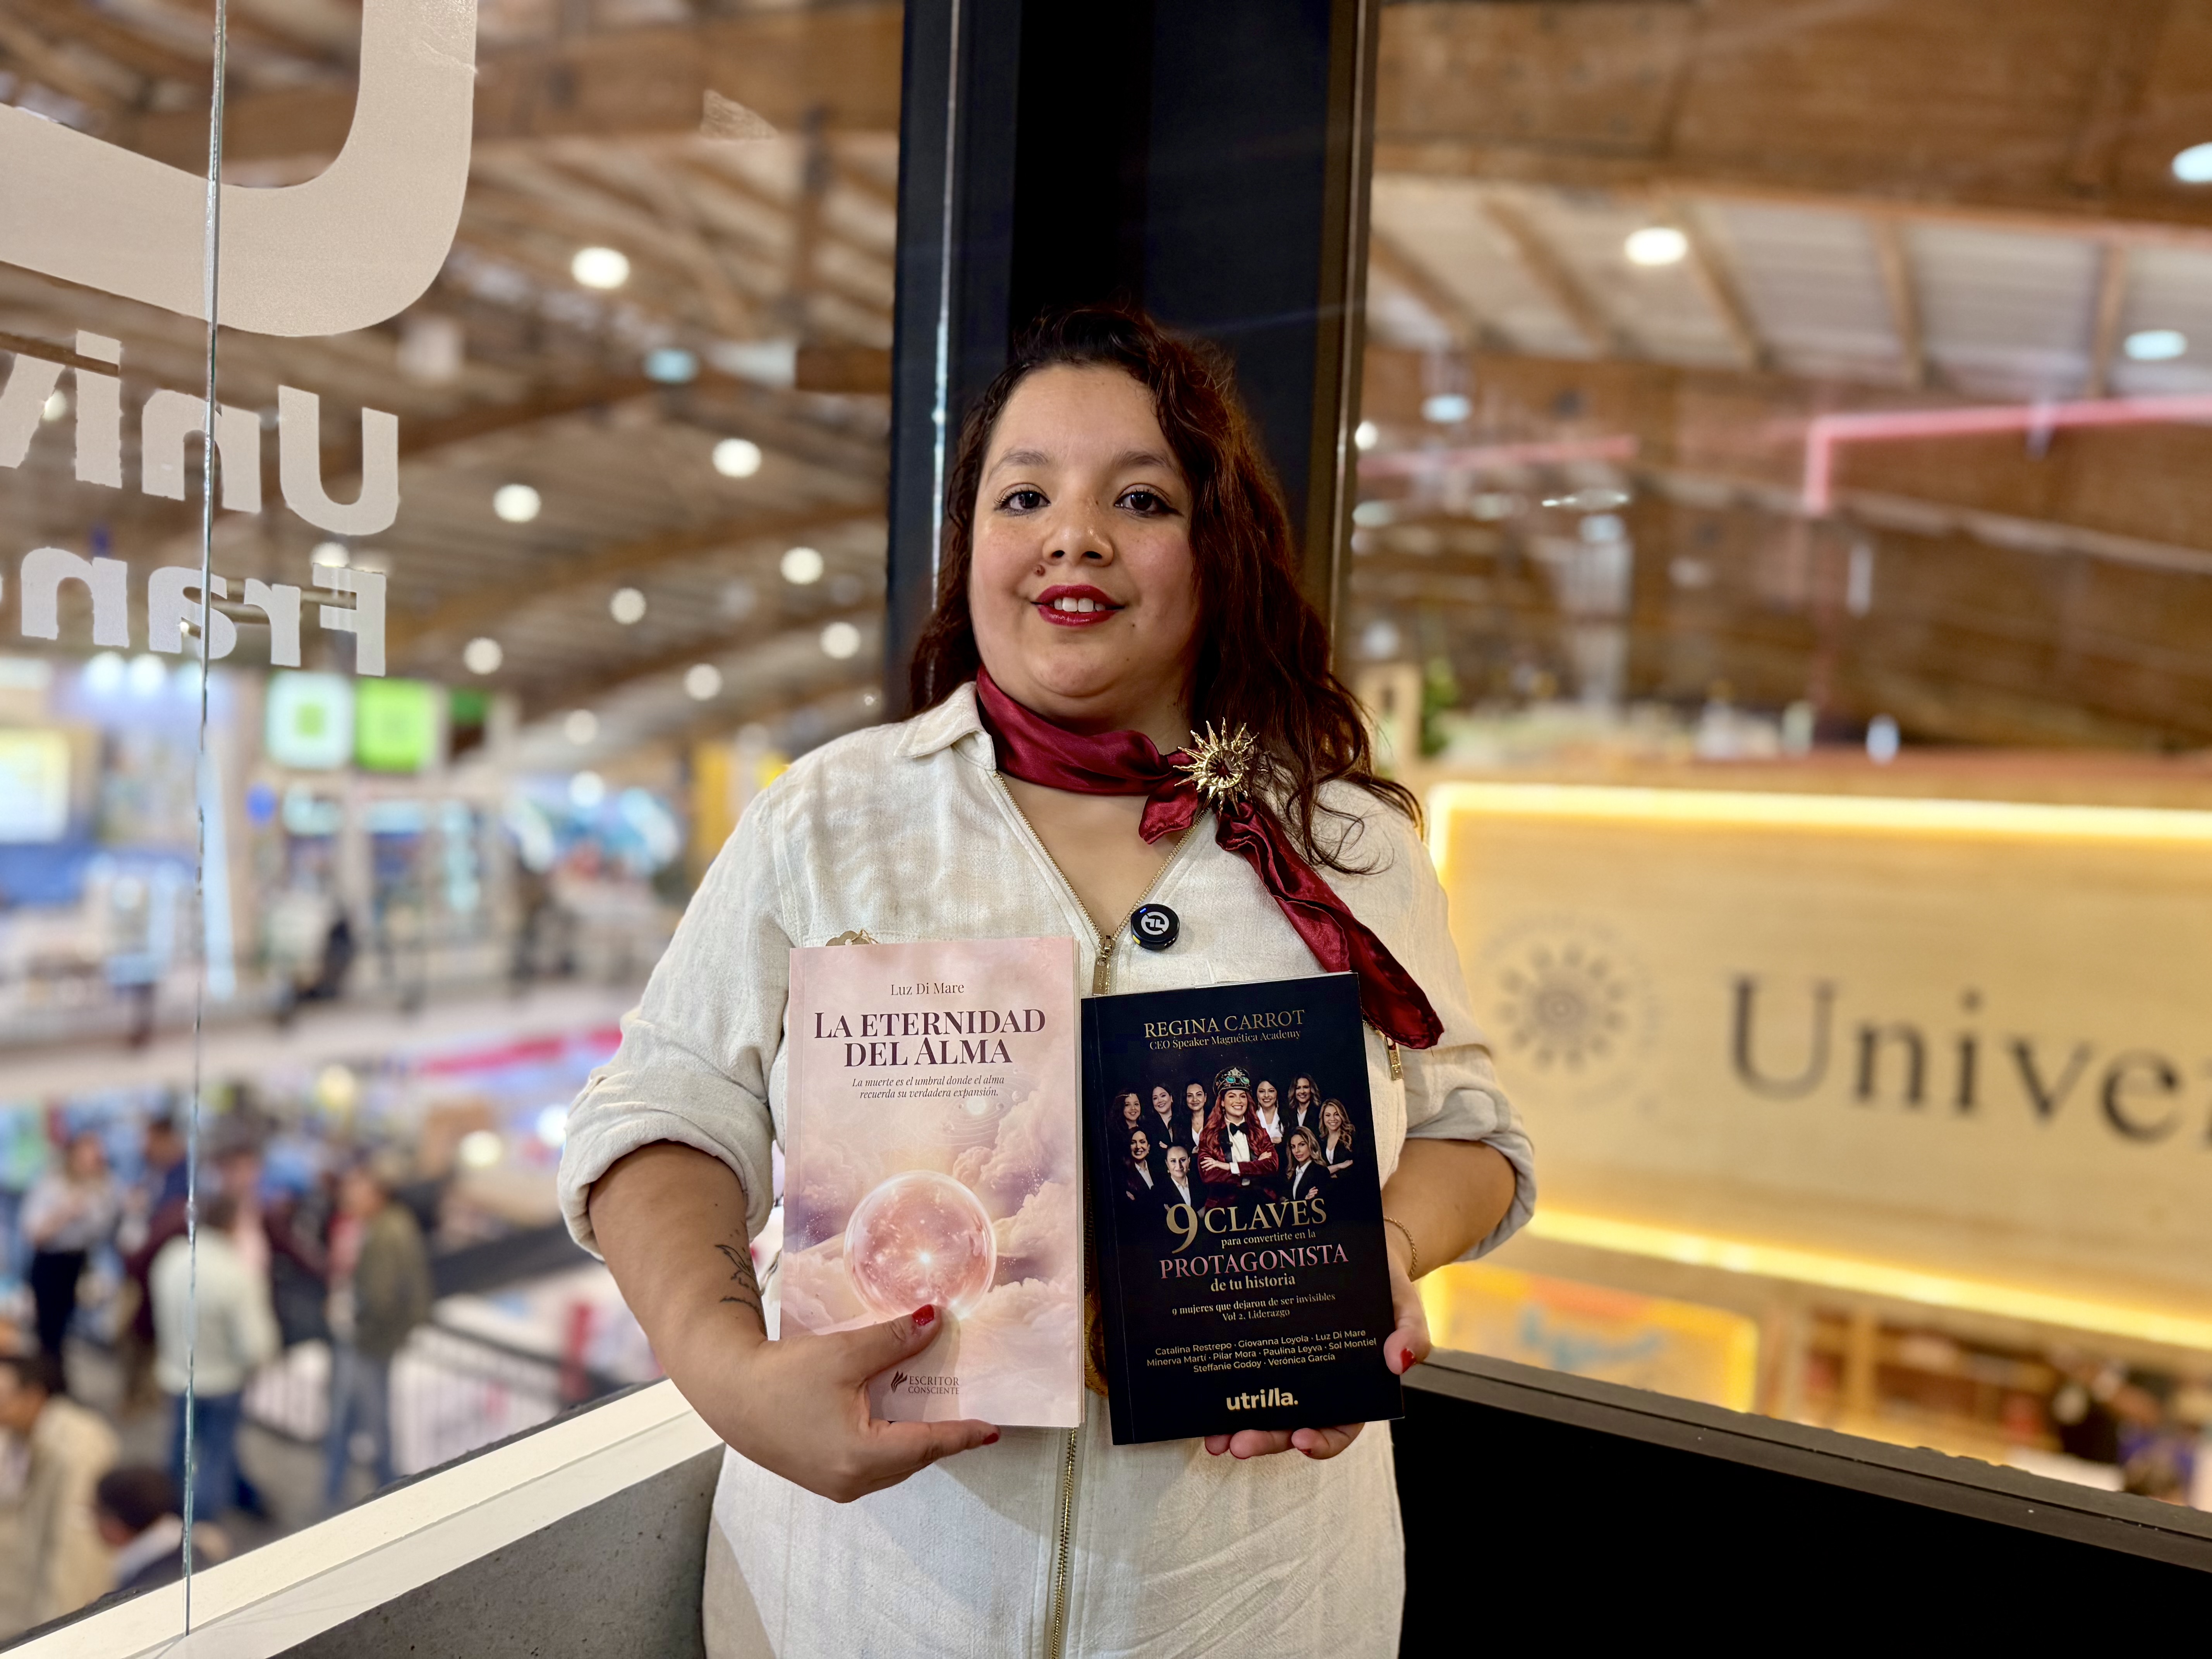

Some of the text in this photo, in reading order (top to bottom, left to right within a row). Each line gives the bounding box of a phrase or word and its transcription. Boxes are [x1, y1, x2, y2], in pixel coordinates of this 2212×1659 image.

[891, 982, 964, 995] Luz Di Mare
[814, 1009, 1045, 1038] LA ETERNIDAD
[1144, 1010, 1305, 1038] REGINA CARROT
[1150, 1030, 1300, 1050] CEO Speaker Magnética Academy
[844, 1037, 1013, 1067] DEL ALMA
[1728, 974, 2212, 1145] Unive
[852, 1079, 862, 1087] La
[865, 1078, 894, 1087] muerte
[906, 1077, 913, 1085] el
[915, 1076, 945, 1085] umbral
[946, 1075, 972, 1085] donde
[974, 1075, 982, 1084] el
[983, 1075, 1004, 1084] alma
[860, 1089, 895, 1098] recuerda
[910, 1088, 951, 1097] verdadera
[953, 1087, 998, 1098] expansión.
[1166, 1198, 1326, 1254] 9 CLAVES
[1221, 1238, 1241, 1249] para
[1243, 1232, 1292, 1244] convertirte
[1308, 1229, 1316, 1238] la
[1159, 1243, 1349, 1279] PROTAGONISTA
[1211, 1273, 1295, 1291] de tu historia
[1180, 1305, 1214, 1315] mujeres
[1216, 1304, 1231, 1312] que
[1233, 1300, 1266, 1310] dejaron
[1268, 1298, 1278, 1306] de
[1296, 1293, 1336, 1304] invisibles
[1222, 1312, 1236, 1321] Vol
[1248, 1309, 1290, 1319] Liderazgo
[1147, 1338, 1377, 1366] Minerva Martí Pilar Mora Paulina Leyva Sol Montiel
[1155, 1346, 1190, 1355] Catalina
[1193, 1343, 1231, 1352] Restrepo
[1238, 1339, 1279, 1348] Giovanna
[1281, 1335, 1309, 1345] Loyola
[1333, 1331, 1342, 1339] Di
[1345, 1330, 1366, 1338] Mare
[1194, 1353, 1335, 1372] Steffanie Godoy Verónica García
[908, 1386, 960, 1395] CONSCIENTE
[909, 1376, 960, 1386] ESCRITOR
